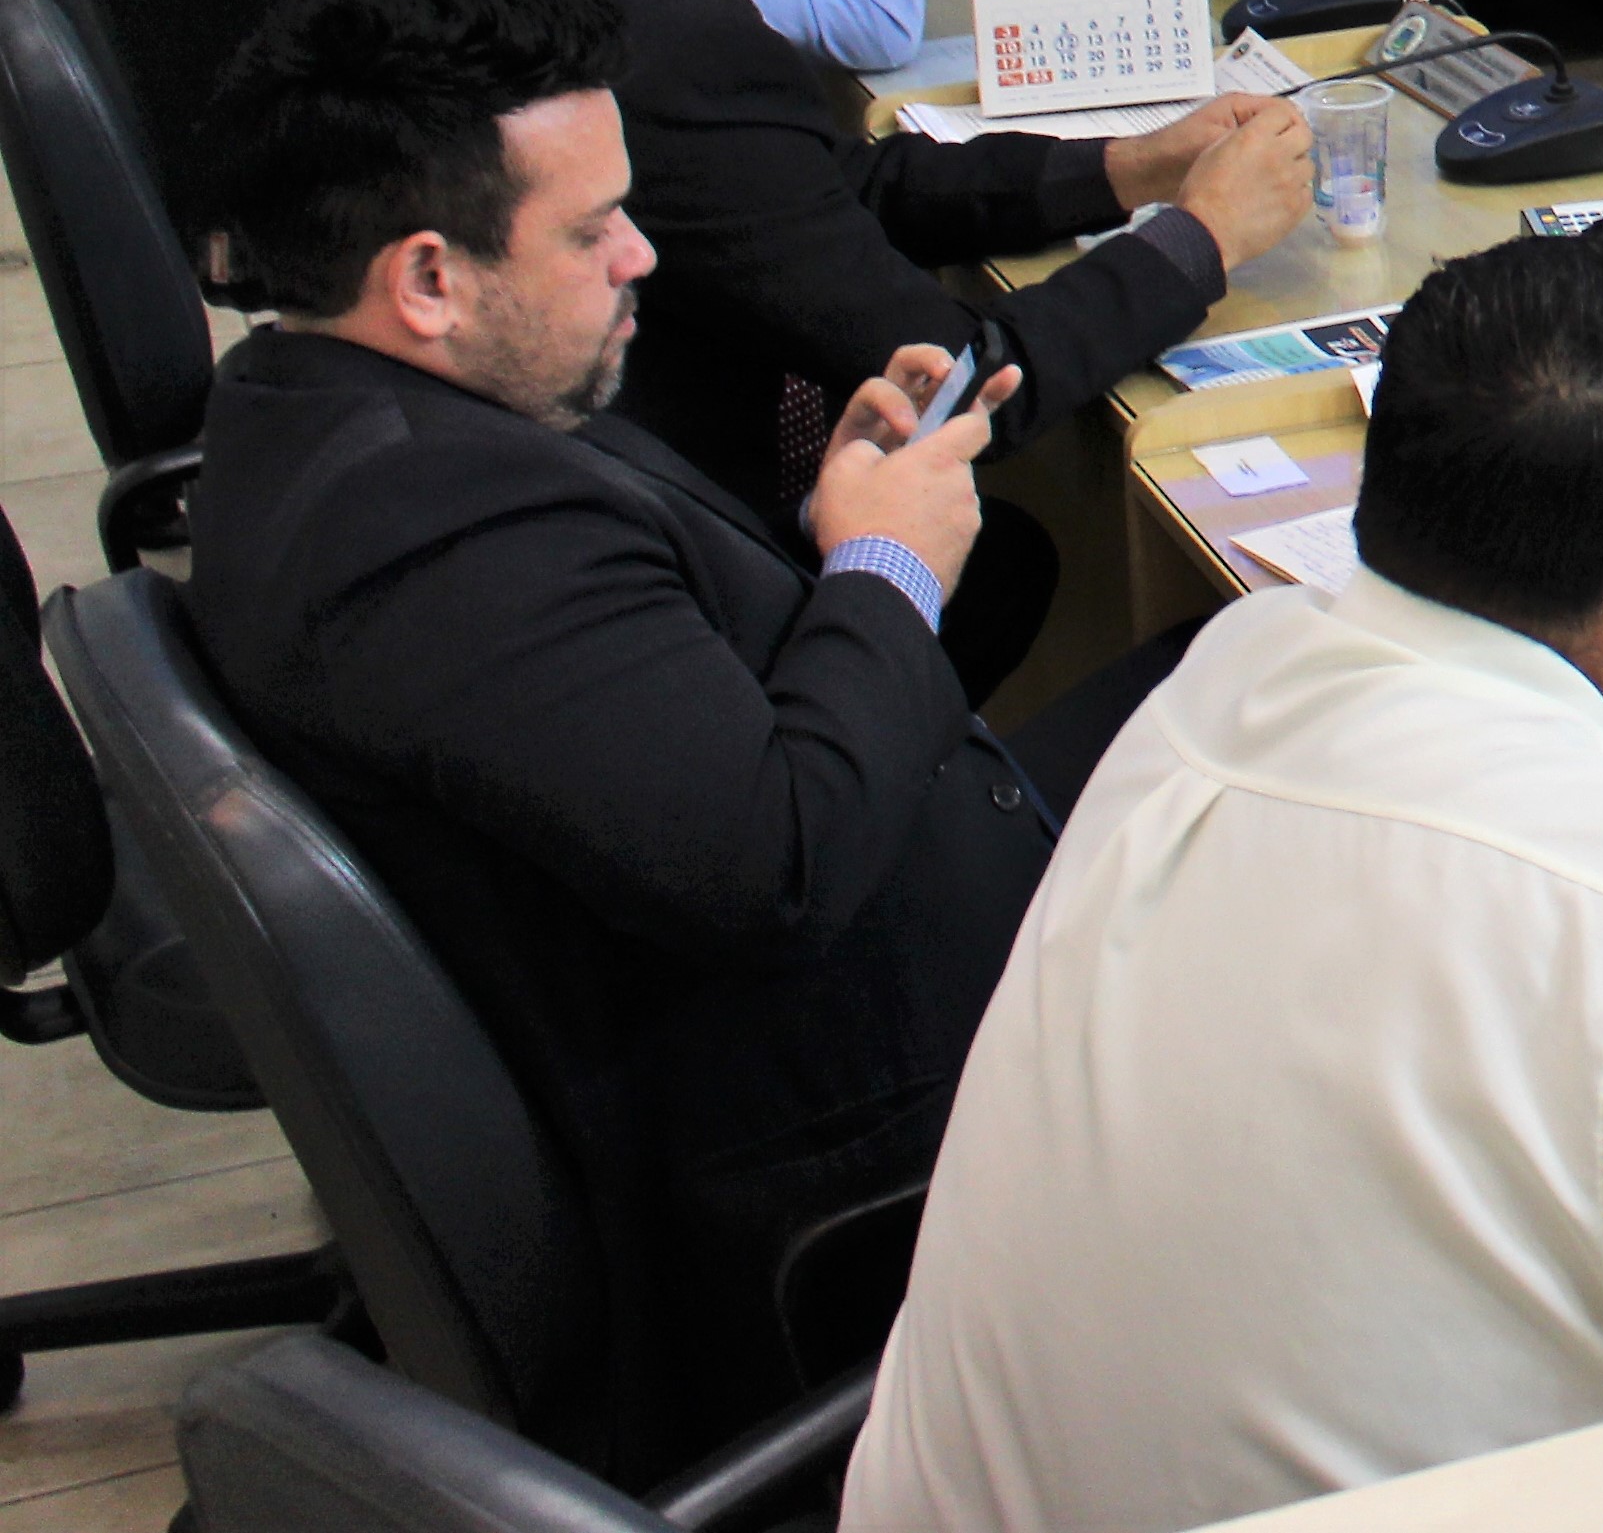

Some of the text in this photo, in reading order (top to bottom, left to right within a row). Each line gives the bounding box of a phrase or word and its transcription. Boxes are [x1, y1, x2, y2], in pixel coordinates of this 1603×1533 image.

[1032, 24, 1039, 35] 4
[1061, 21, 1071, 31] 5
[1089, 20, 1098, 30] 6
[1118, 16, 1125, 27] 7
[1147, 14, 1154, 24] 8
[1174, 10, 1183, 21] 9
[1029, 40, 1043, 50] 11
[1060, 35, 1076, 47] 12
[1087, 35, 1103, 46] 13
[1116, 32, 1131, 43] 14
[1145, 29, 1159, 40] 15
[1174, 28, 1188, 38] 16
[1031, 55, 1046, 66] 18
[1058, 52, 1075, 64] 19
[1089, 50, 1104, 61] 20
[1117, 48, 1131, 59] 21
[1145, 45, 1161, 56] 22
[1174, 42, 1189, 54] 23
[1061, 58, 1191, 80] 26 27 28 29 30
